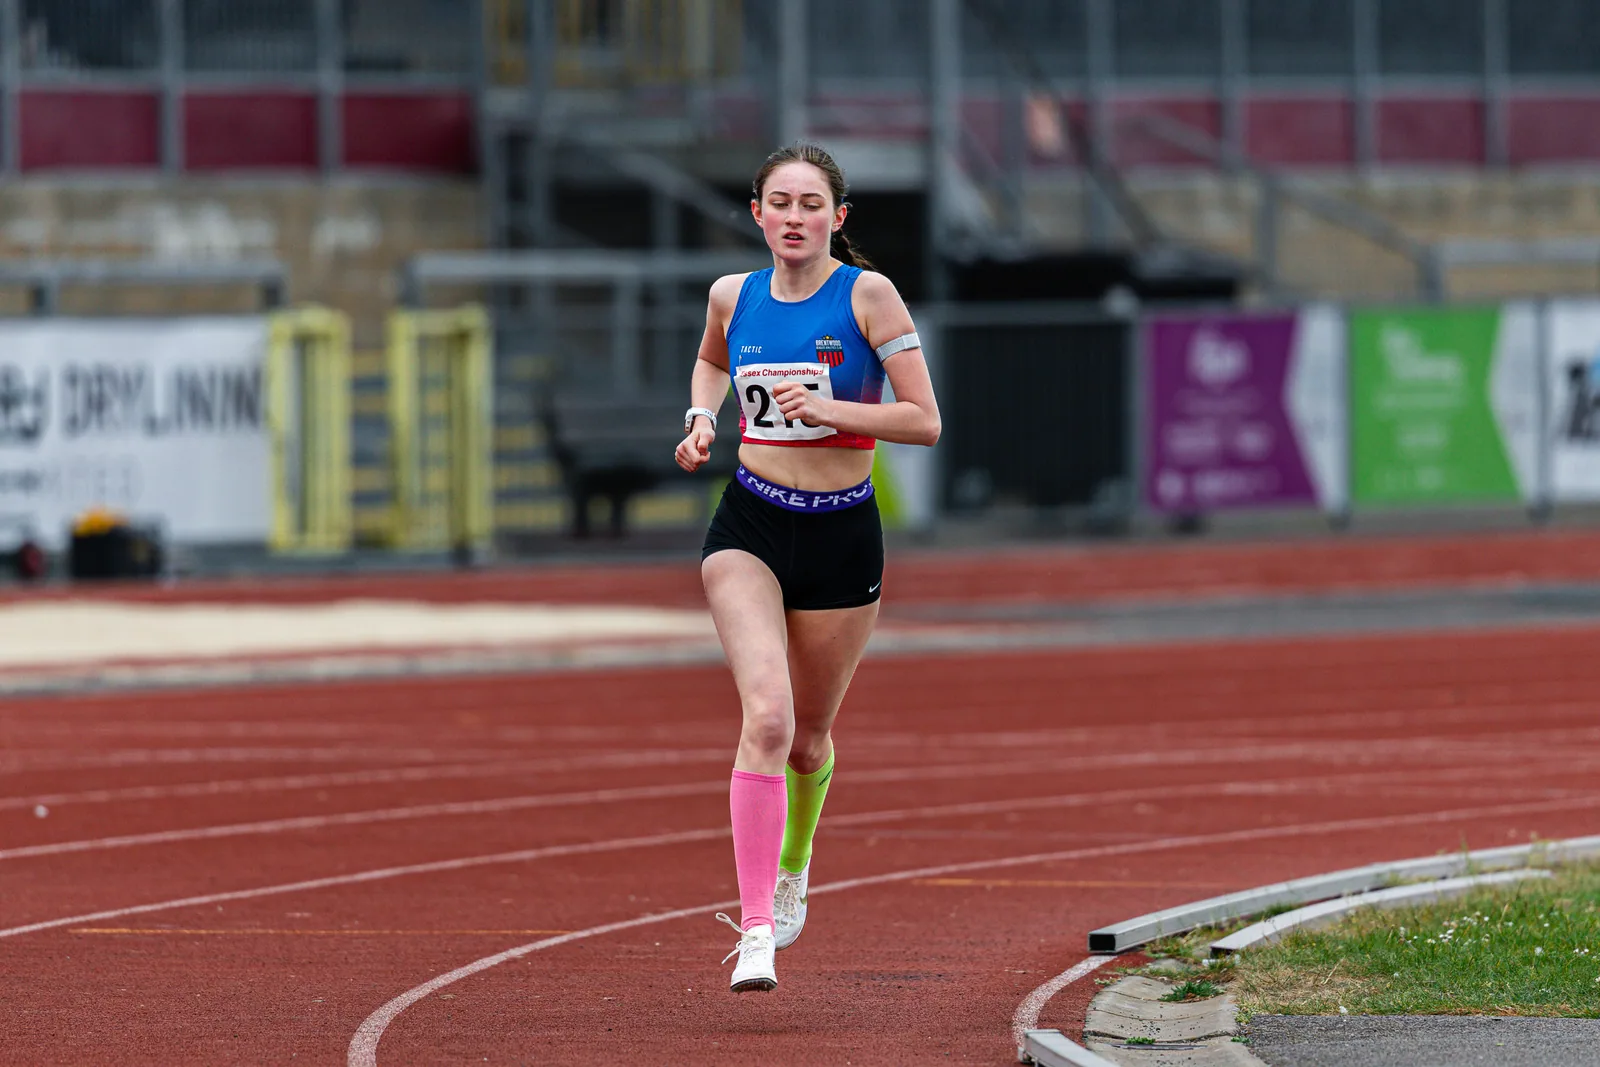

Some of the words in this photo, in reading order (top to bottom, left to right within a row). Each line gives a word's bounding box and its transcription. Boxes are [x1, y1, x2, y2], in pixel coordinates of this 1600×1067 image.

[740, 345, 763, 354] TACTIC
[762, 367, 824, 378] Championships
[746, 476, 807, 508] NIKE
